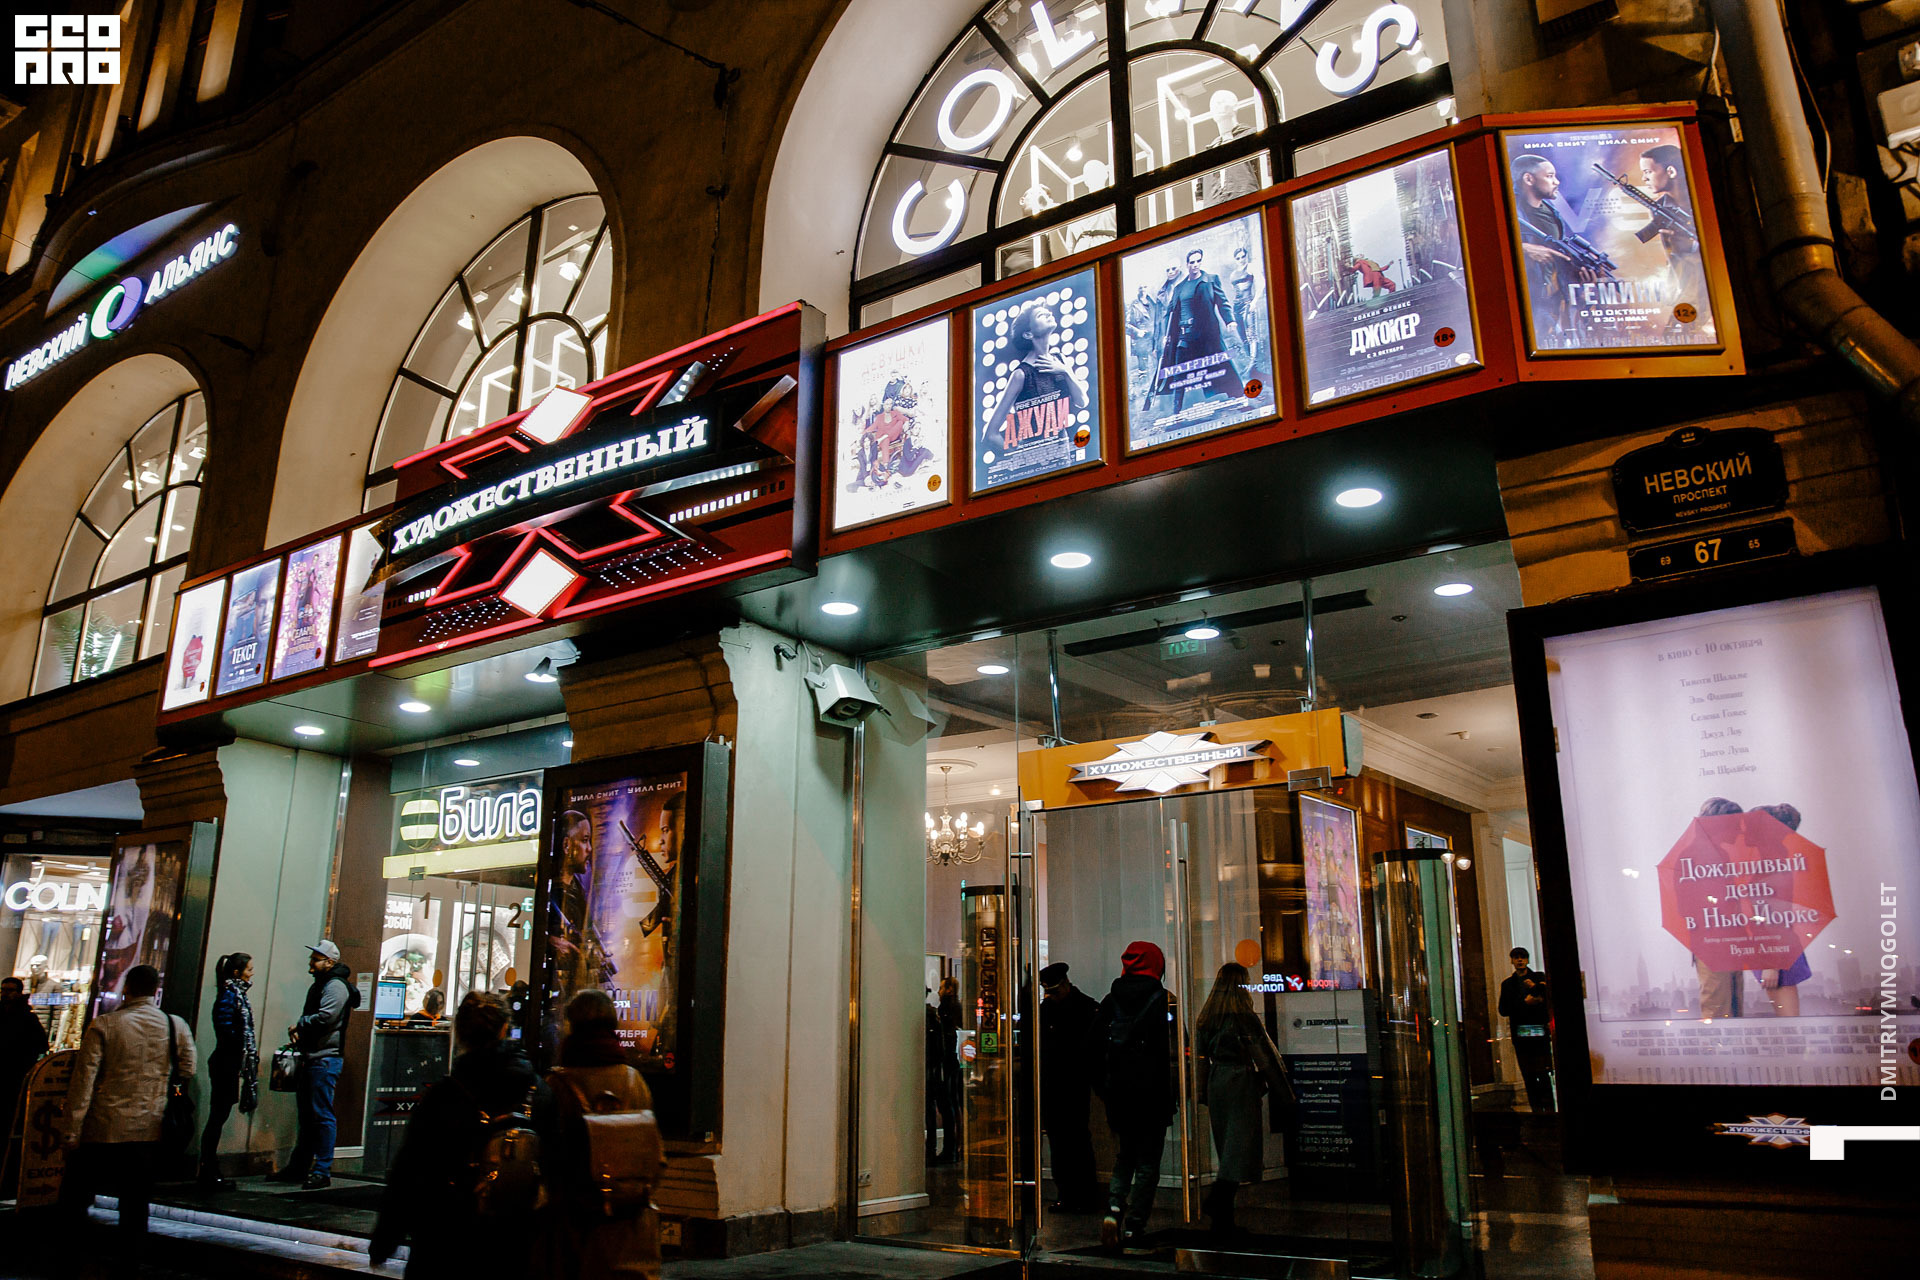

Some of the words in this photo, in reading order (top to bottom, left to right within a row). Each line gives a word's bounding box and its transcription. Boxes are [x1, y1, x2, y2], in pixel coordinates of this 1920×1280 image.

[1557, 140, 1586, 148] СМИТ
[1630, 137, 1661, 145] СМИТ
[1568, 281, 1664, 306] ГЕМИНИ
[5, 313, 90, 391] НЕВСКИЙ
[144, 223, 240, 304] АЛЬЯНС
[1383, 301, 1412, 313] ФЕНИКС
[1605, 307, 1661, 316] ОКТЯБРЯ
[1675, 309, 1696, 318] 12+
[1349, 312, 1421, 356] ДЖОКЕР
[1434, 332, 1455, 343] 18+
[1378, 345, 1404, 356] ОКТЯБРЯ
[1163, 352, 1230, 378] МАТРИЦА
[1338, 385, 1351, 396] 18+
[1351, 371, 1405, 393] ЗАПРЕЩЕНО
[1405, 366, 1423, 381] ДЛЯ
[1423, 358, 1452, 376] ДЕТЕЙ
[1245, 383, 1262, 395] 16+
[1003, 396, 1070, 450] ДЖУДИ
[1644, 451, 1752, 495] НЕВСКИЙ
[391, 415, 709, 555] ХУДОЖЕСТВЕННЫЙ
[1673, 485, 1728, 504] ПРОСПЕКТ
[1675, 509, 1699, 518] NEVSKY
[1700, 502, 1731, 513] PROSPEKT
[1694, 538, 1721, 564] 67
[1748, 539, 1760, 549] 65
[232, 642, 258, 665] ТЕКСТ
[1705, 642, 1717, 654] 10
[1088, 746, 1243, 776] ХУДОЖЕСТВЕННЫЙ
[570, 793, 595, 803] УИЛЛ
[597, 789, 620, 799] СМИТ
[627, 785, 654, 794] УИЛЛ
[656, 780, 682, 791] СМИТ
[1679, 853, 1807, 883] Дождливый
[1725, 882, 1774, 901] день
[507, 902, 522, 928] 2
[1685, 916, 1697, 929] в
[1730, 944, 1755, 956] Вуди
[1758, 943, 1790, 954] Аллен
